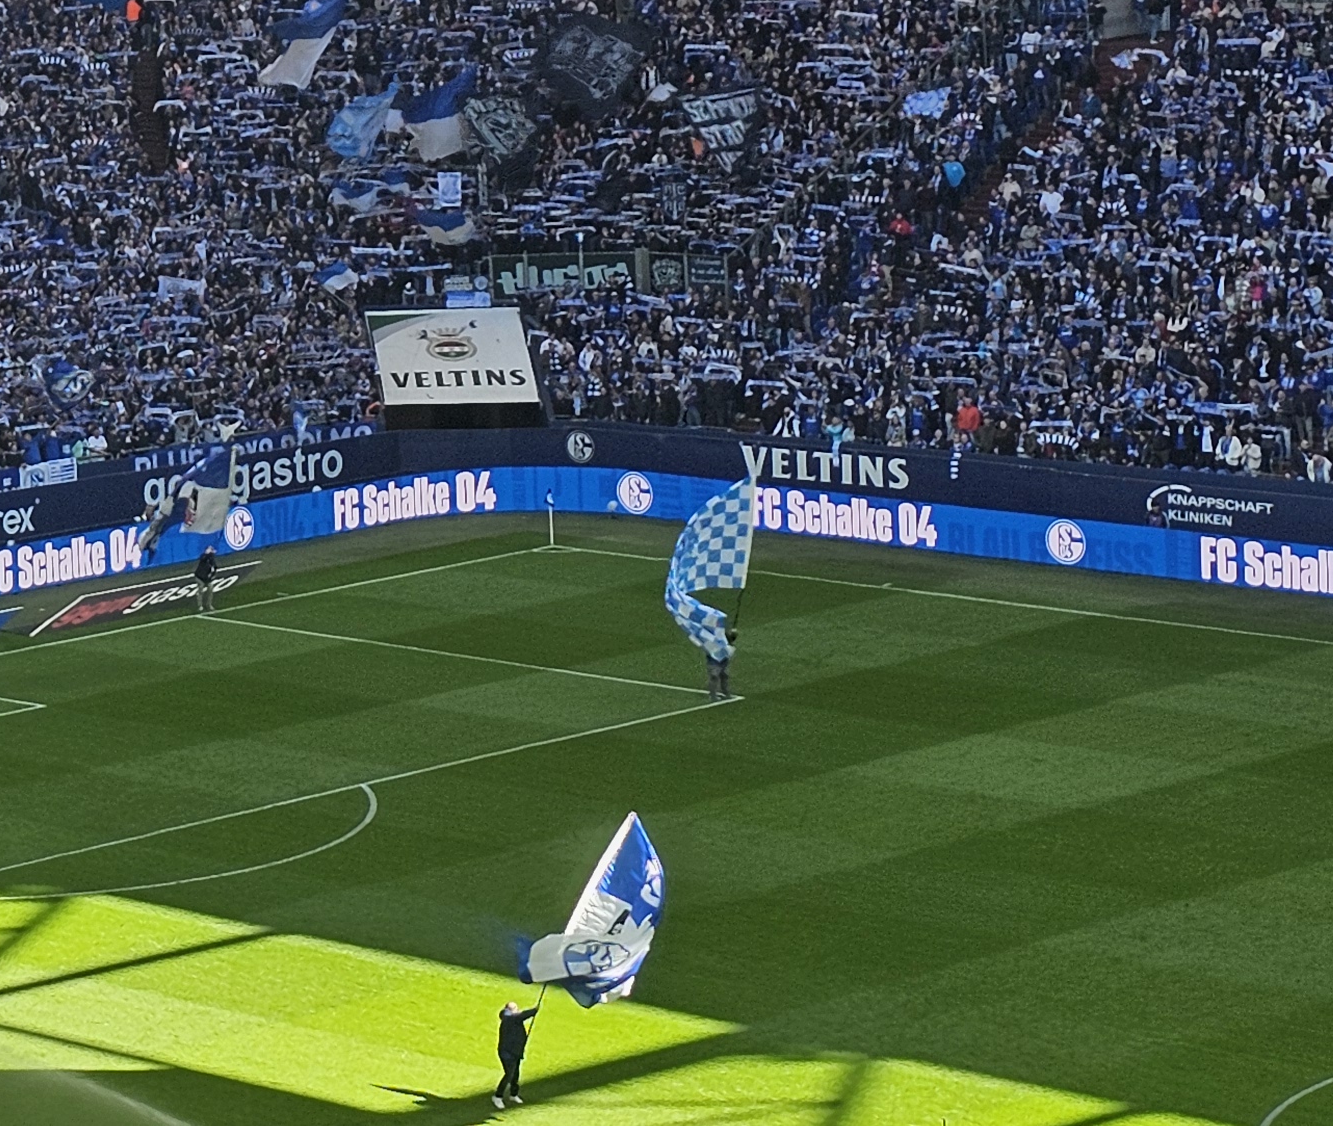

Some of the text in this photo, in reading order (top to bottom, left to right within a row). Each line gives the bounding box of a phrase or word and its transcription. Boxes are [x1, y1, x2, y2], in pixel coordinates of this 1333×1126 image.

[390, 368, 528, 391] VELTINS
[739, 443, 910, 490] VELTINS
[334, 487, 361, 532] FC
[363, 475, 451, 528] Schalke
[455, 470, 497, 512] 04
[751, 486, 938, 548] FC Schalke 04
[1166, 491, 1275, 516] KNAPPSCHAFT
[1167, 509, 1233, 528] KLINIKEN
[17, 535, 106, 590] Schalke
[109, 526, 142, 570] 04
[1199, 535, 1238, 582] FC
